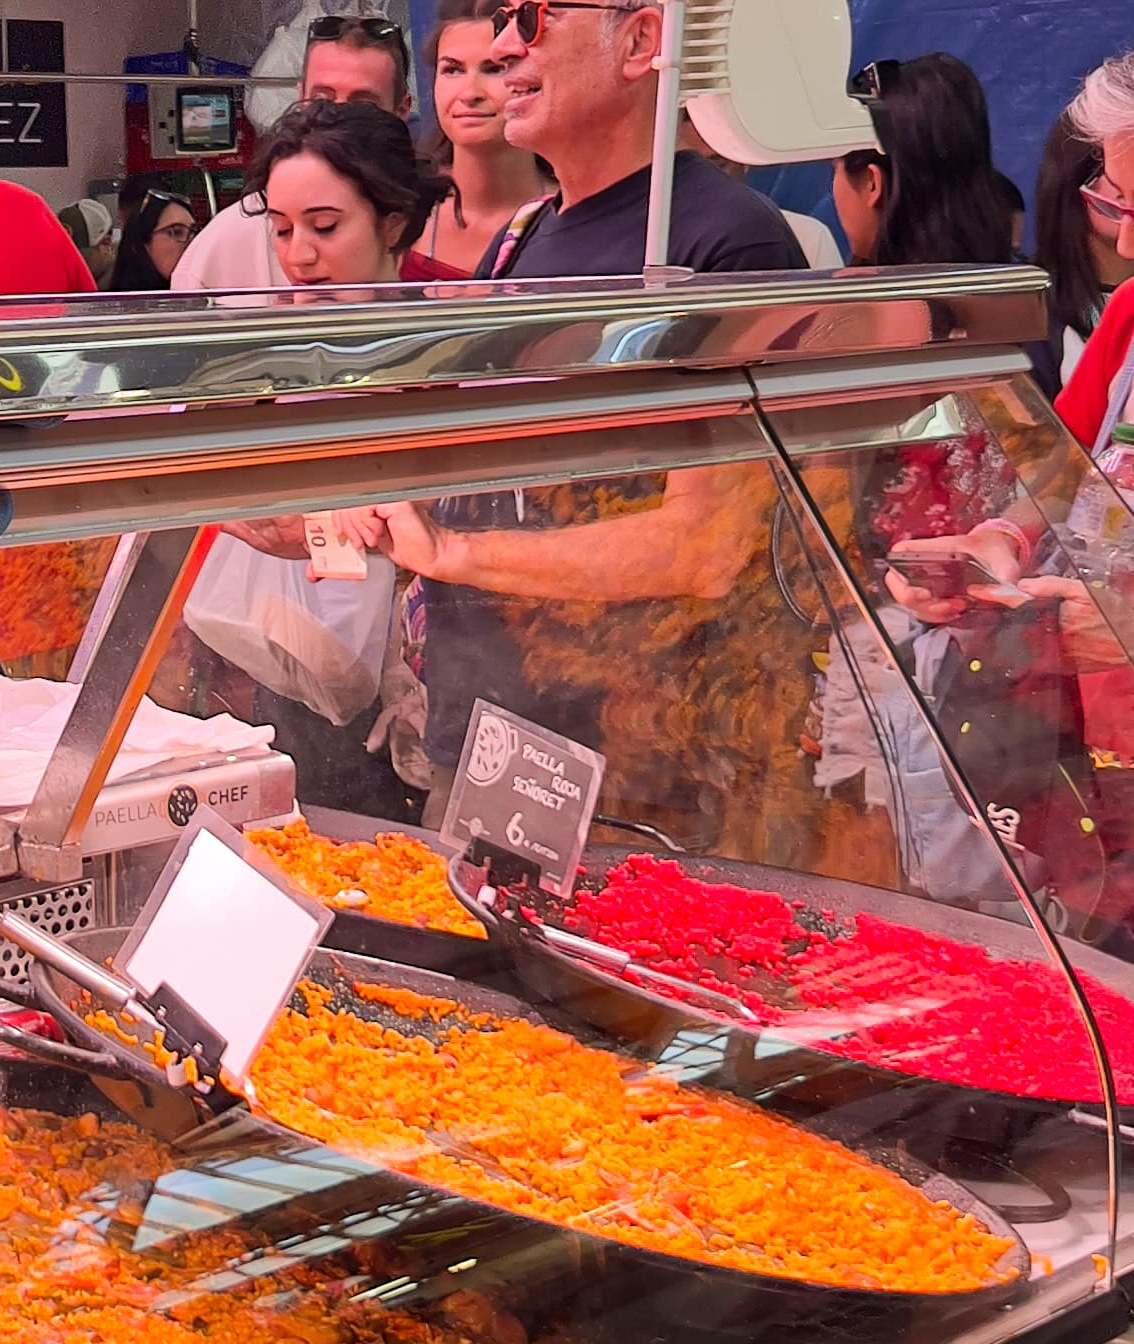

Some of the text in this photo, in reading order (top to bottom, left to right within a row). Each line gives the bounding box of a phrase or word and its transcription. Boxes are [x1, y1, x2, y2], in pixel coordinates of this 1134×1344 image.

[310, 525, 326, 547] 10
[522, 743, 565, 777] PAELLA
[512, 775, 566, 810] SEÑORET
[551, 775, 581, 801] ROJA
[94, 785, 249, 827] PAELLA CHEF
